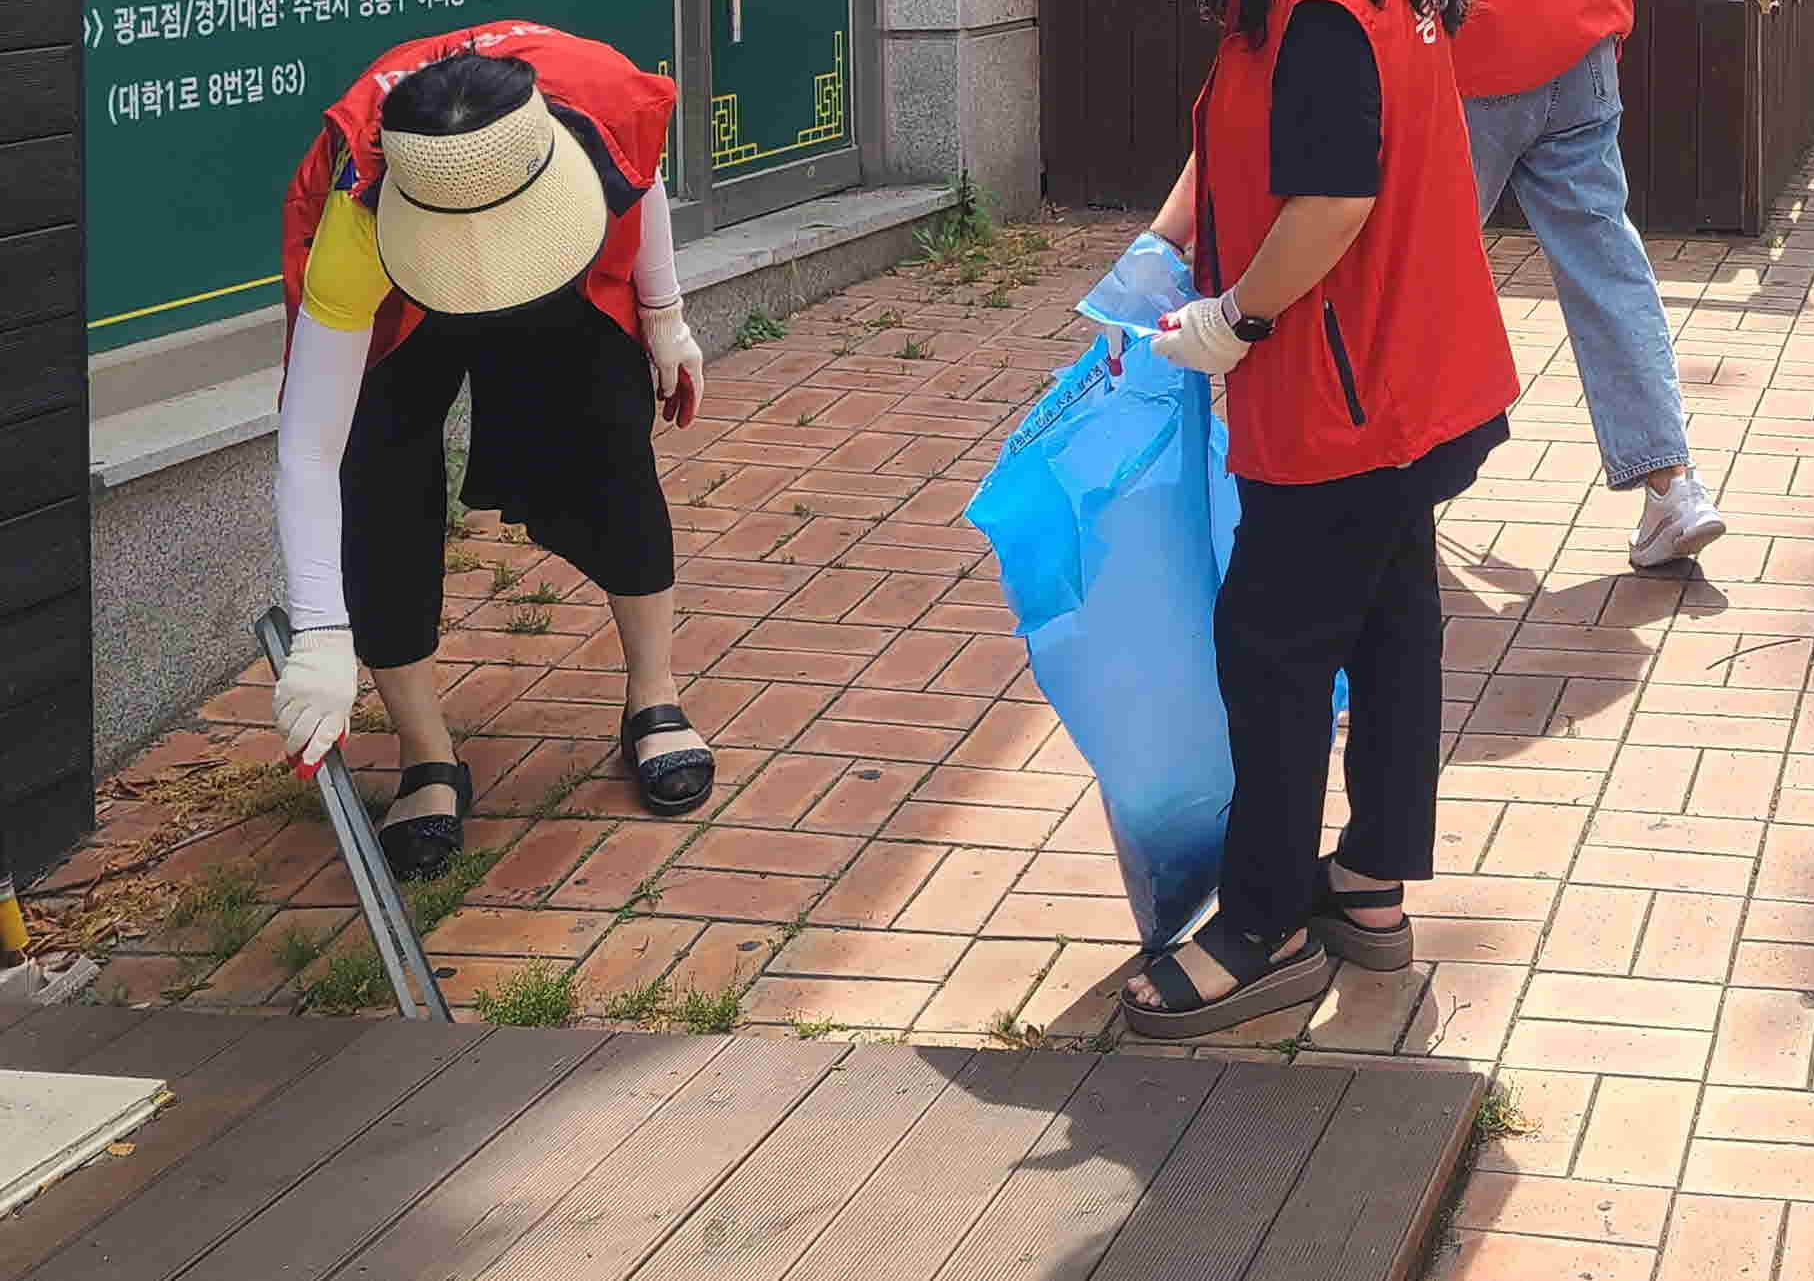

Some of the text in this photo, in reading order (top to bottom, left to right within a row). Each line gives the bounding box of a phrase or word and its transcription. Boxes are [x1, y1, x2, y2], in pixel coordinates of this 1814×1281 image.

[108, 57, 306, 126] (대학1로 8번길 63)
